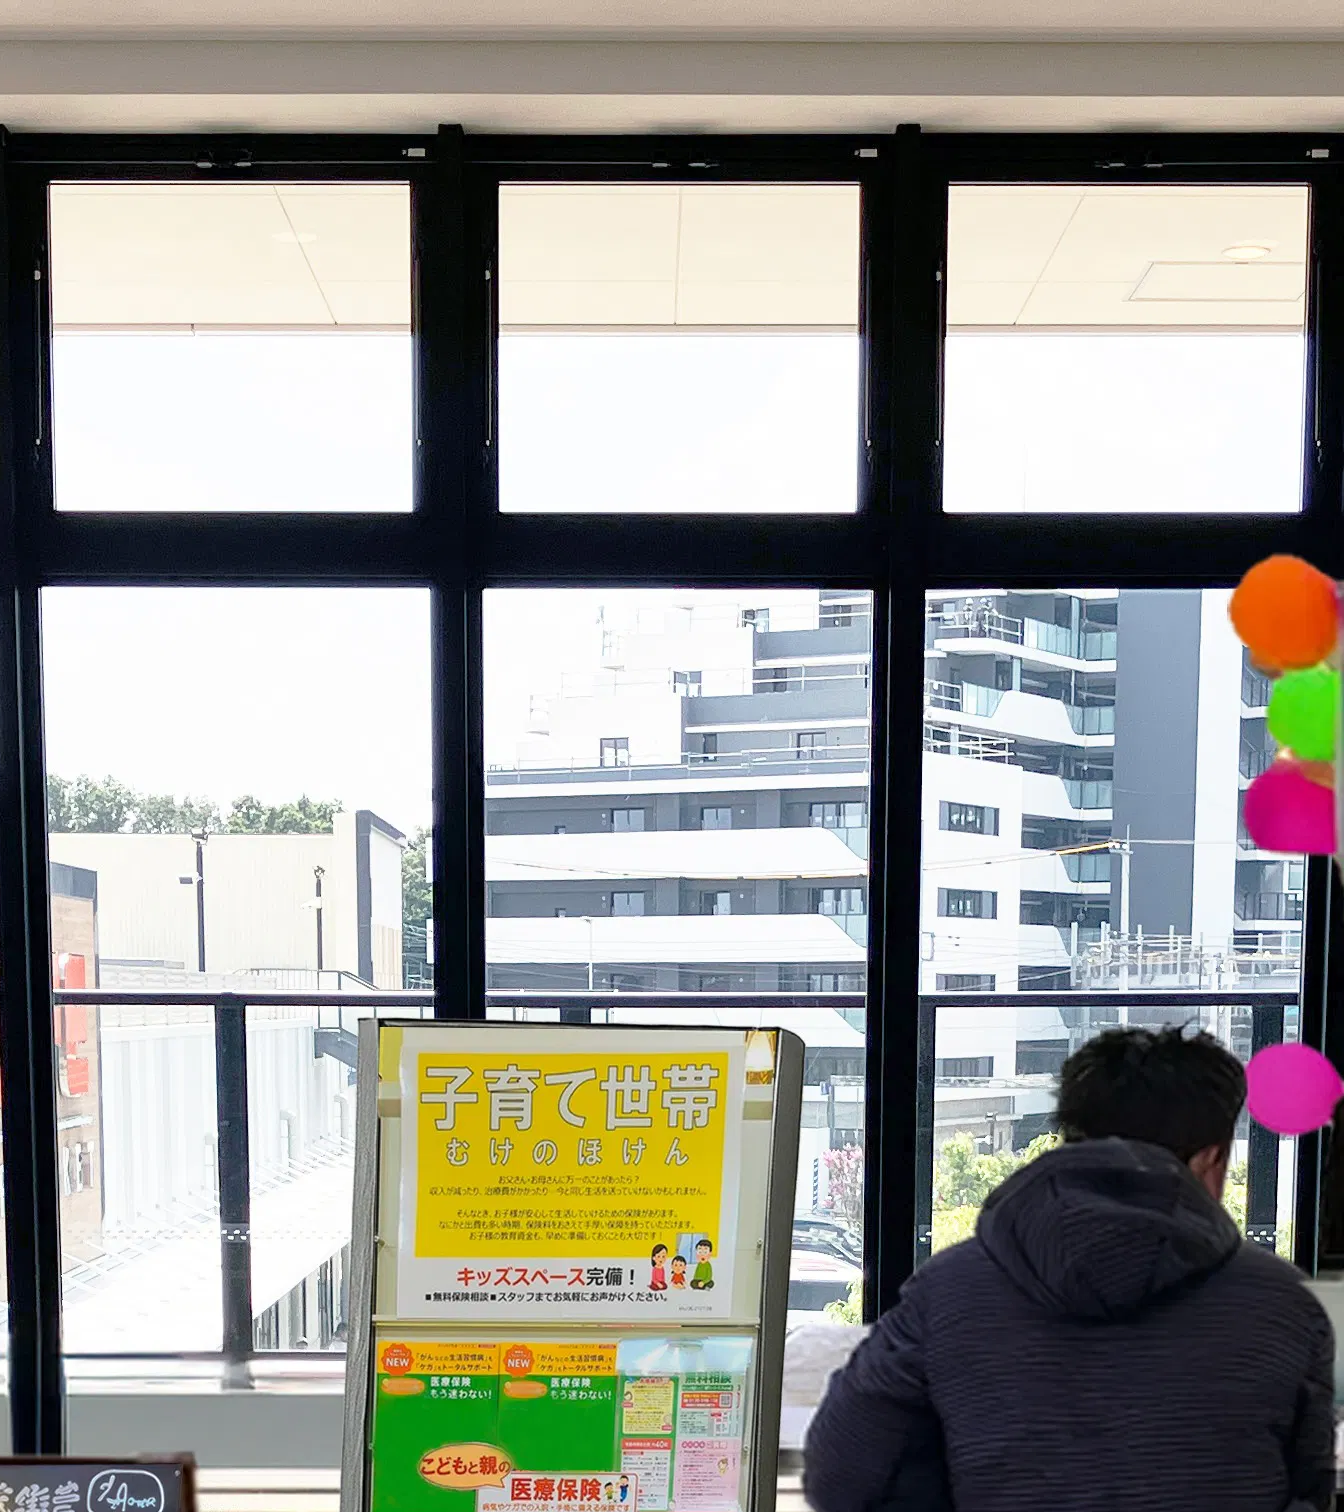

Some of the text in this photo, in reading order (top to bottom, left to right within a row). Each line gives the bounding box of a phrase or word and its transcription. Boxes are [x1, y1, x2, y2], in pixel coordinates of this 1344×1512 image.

[420, 1063, 719, 1131] 子育て世帯
[446, 1137, 690, 1167] むけのほけん
[457, 1267, 635, 1287] キッズスペース完備！
[385, 1358, 409, 1367] NEW
[507, 1359, 530, 1368] NEW
[430, 1376, 471, 1387] 医療保険
[550, 1377, 591, 1388] 医療保険
[420, 1455, 510, 1475] こどもと親の
[511, 1477, 601, 1502] 医療保険
